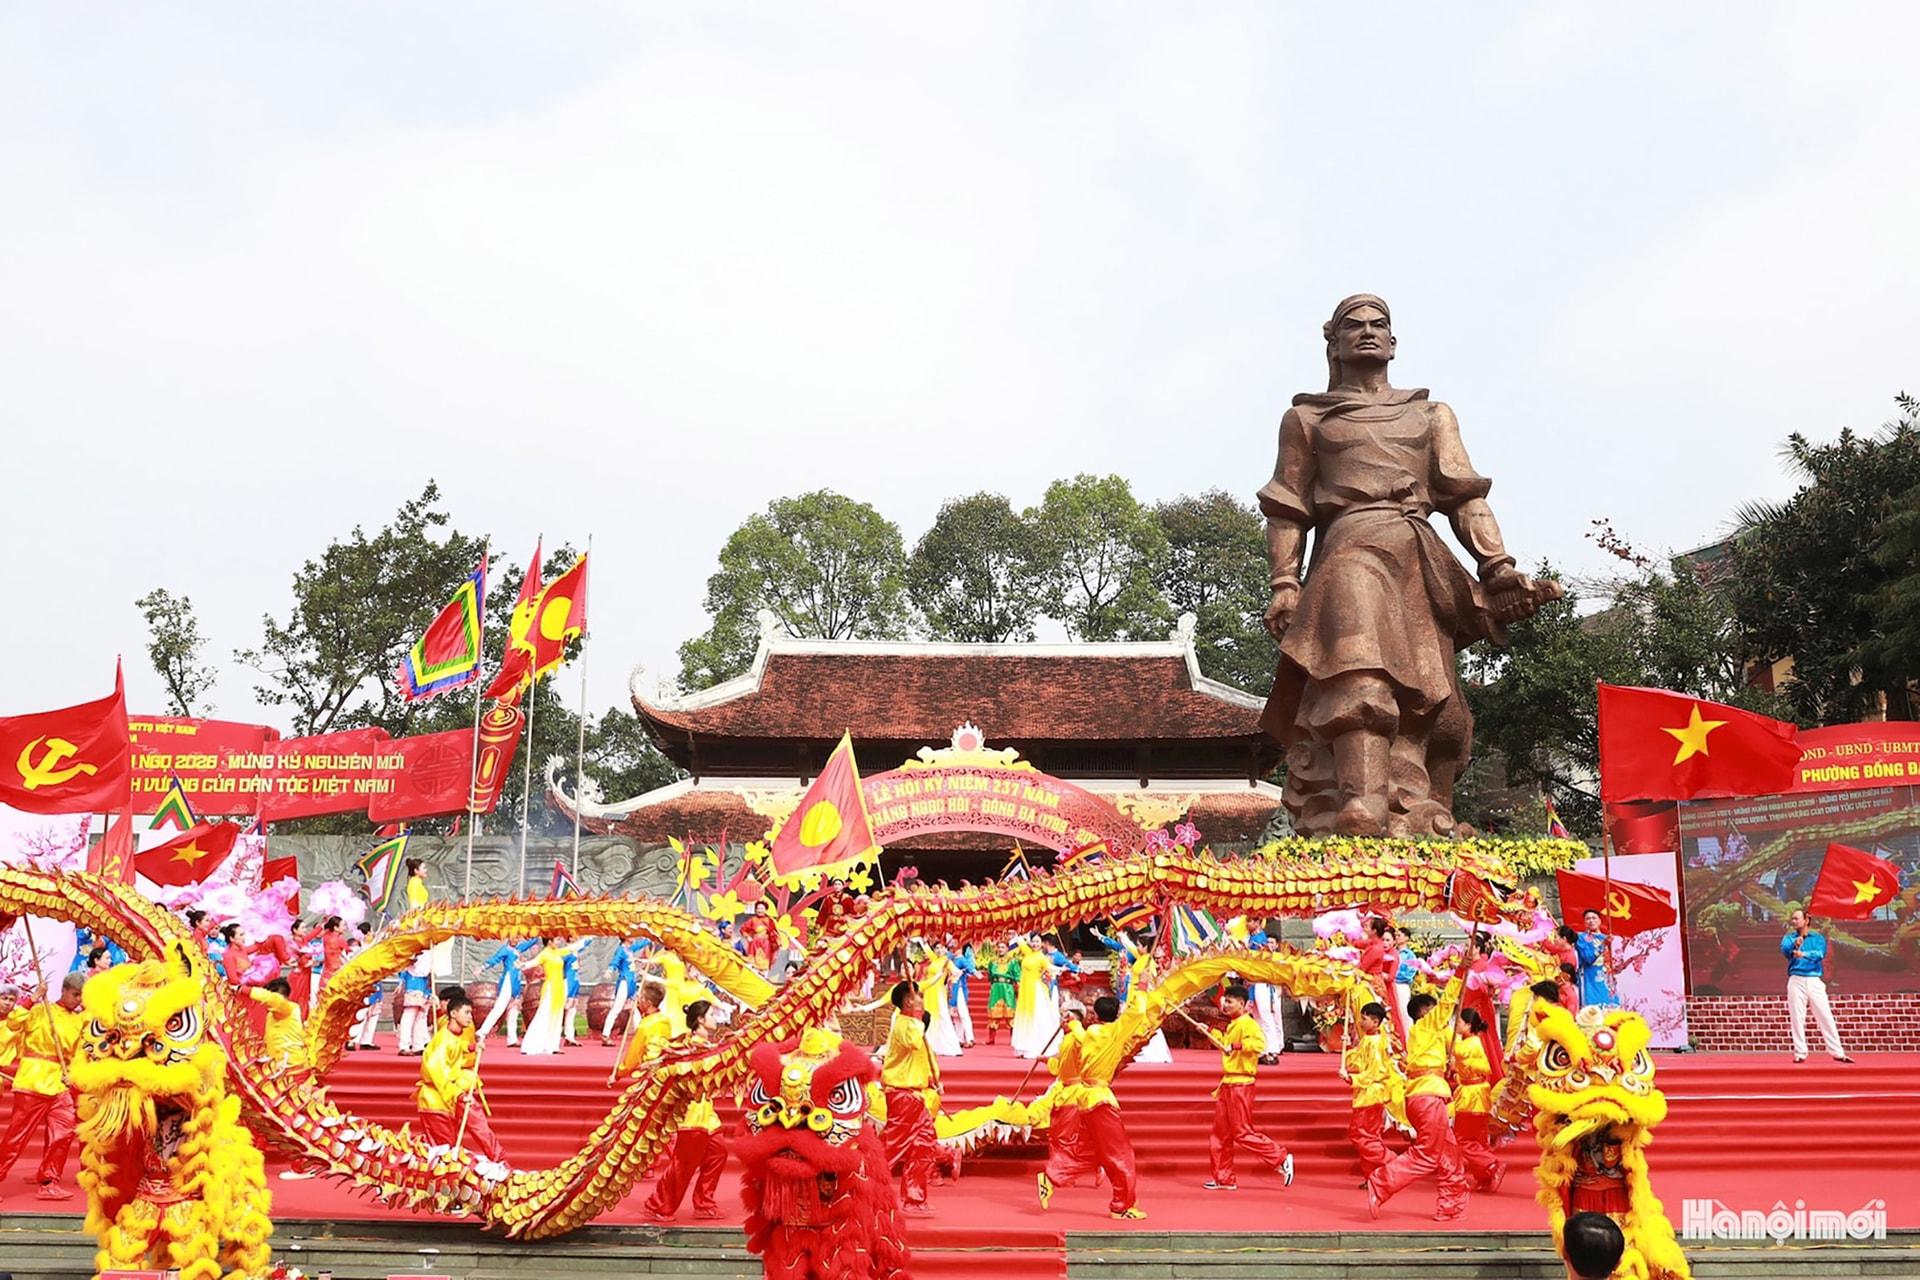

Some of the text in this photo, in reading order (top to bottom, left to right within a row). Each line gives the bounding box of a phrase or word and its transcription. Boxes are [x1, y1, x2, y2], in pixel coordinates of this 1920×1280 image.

[139, 754, 172, 772] NGỌ
[174, 754, 218, 769] 2026
[228, 749, 275, 769] MỪNG
[277, 750, 302, 769] KỶ
[304, 752, 373, 769] NGUYÊN
[376, 752, 405, 769] MỚI
[1835, 743, 1873, 757] UBND
[1801, 760, 1920, 783] PHƯỜNG ĐỐNG Đ
[202, 773, 236, 793] CỦA
[239, 773, 272, 793] DÂN
[276, 775, 309, 796] TỘC
[312, 775, 351, 796] VIỆT
[993, 780, 1020, 797] 237
